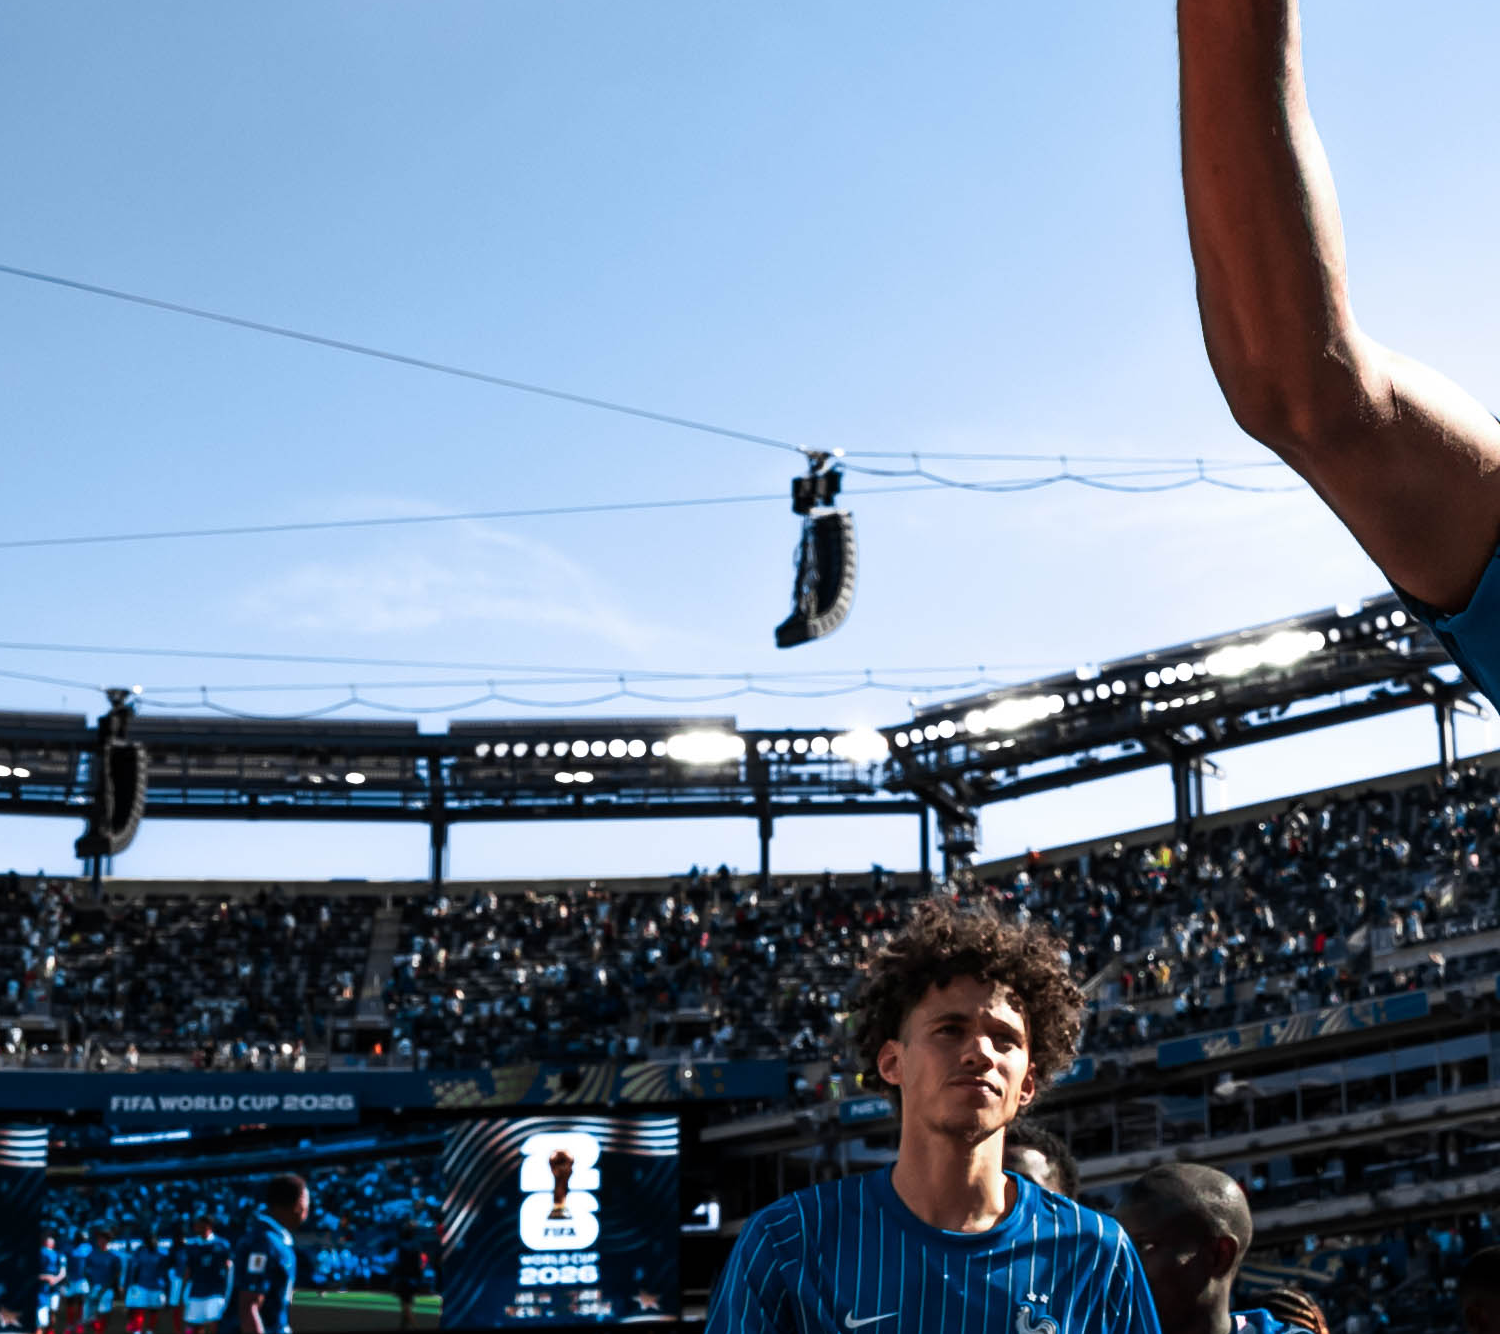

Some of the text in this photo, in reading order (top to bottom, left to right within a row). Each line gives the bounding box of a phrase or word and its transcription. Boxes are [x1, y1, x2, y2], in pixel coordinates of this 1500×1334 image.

[110, 1093, 355, 1112] FIFA WORLD CUP 2026
[519, 1266, 599, 1286] 2026
